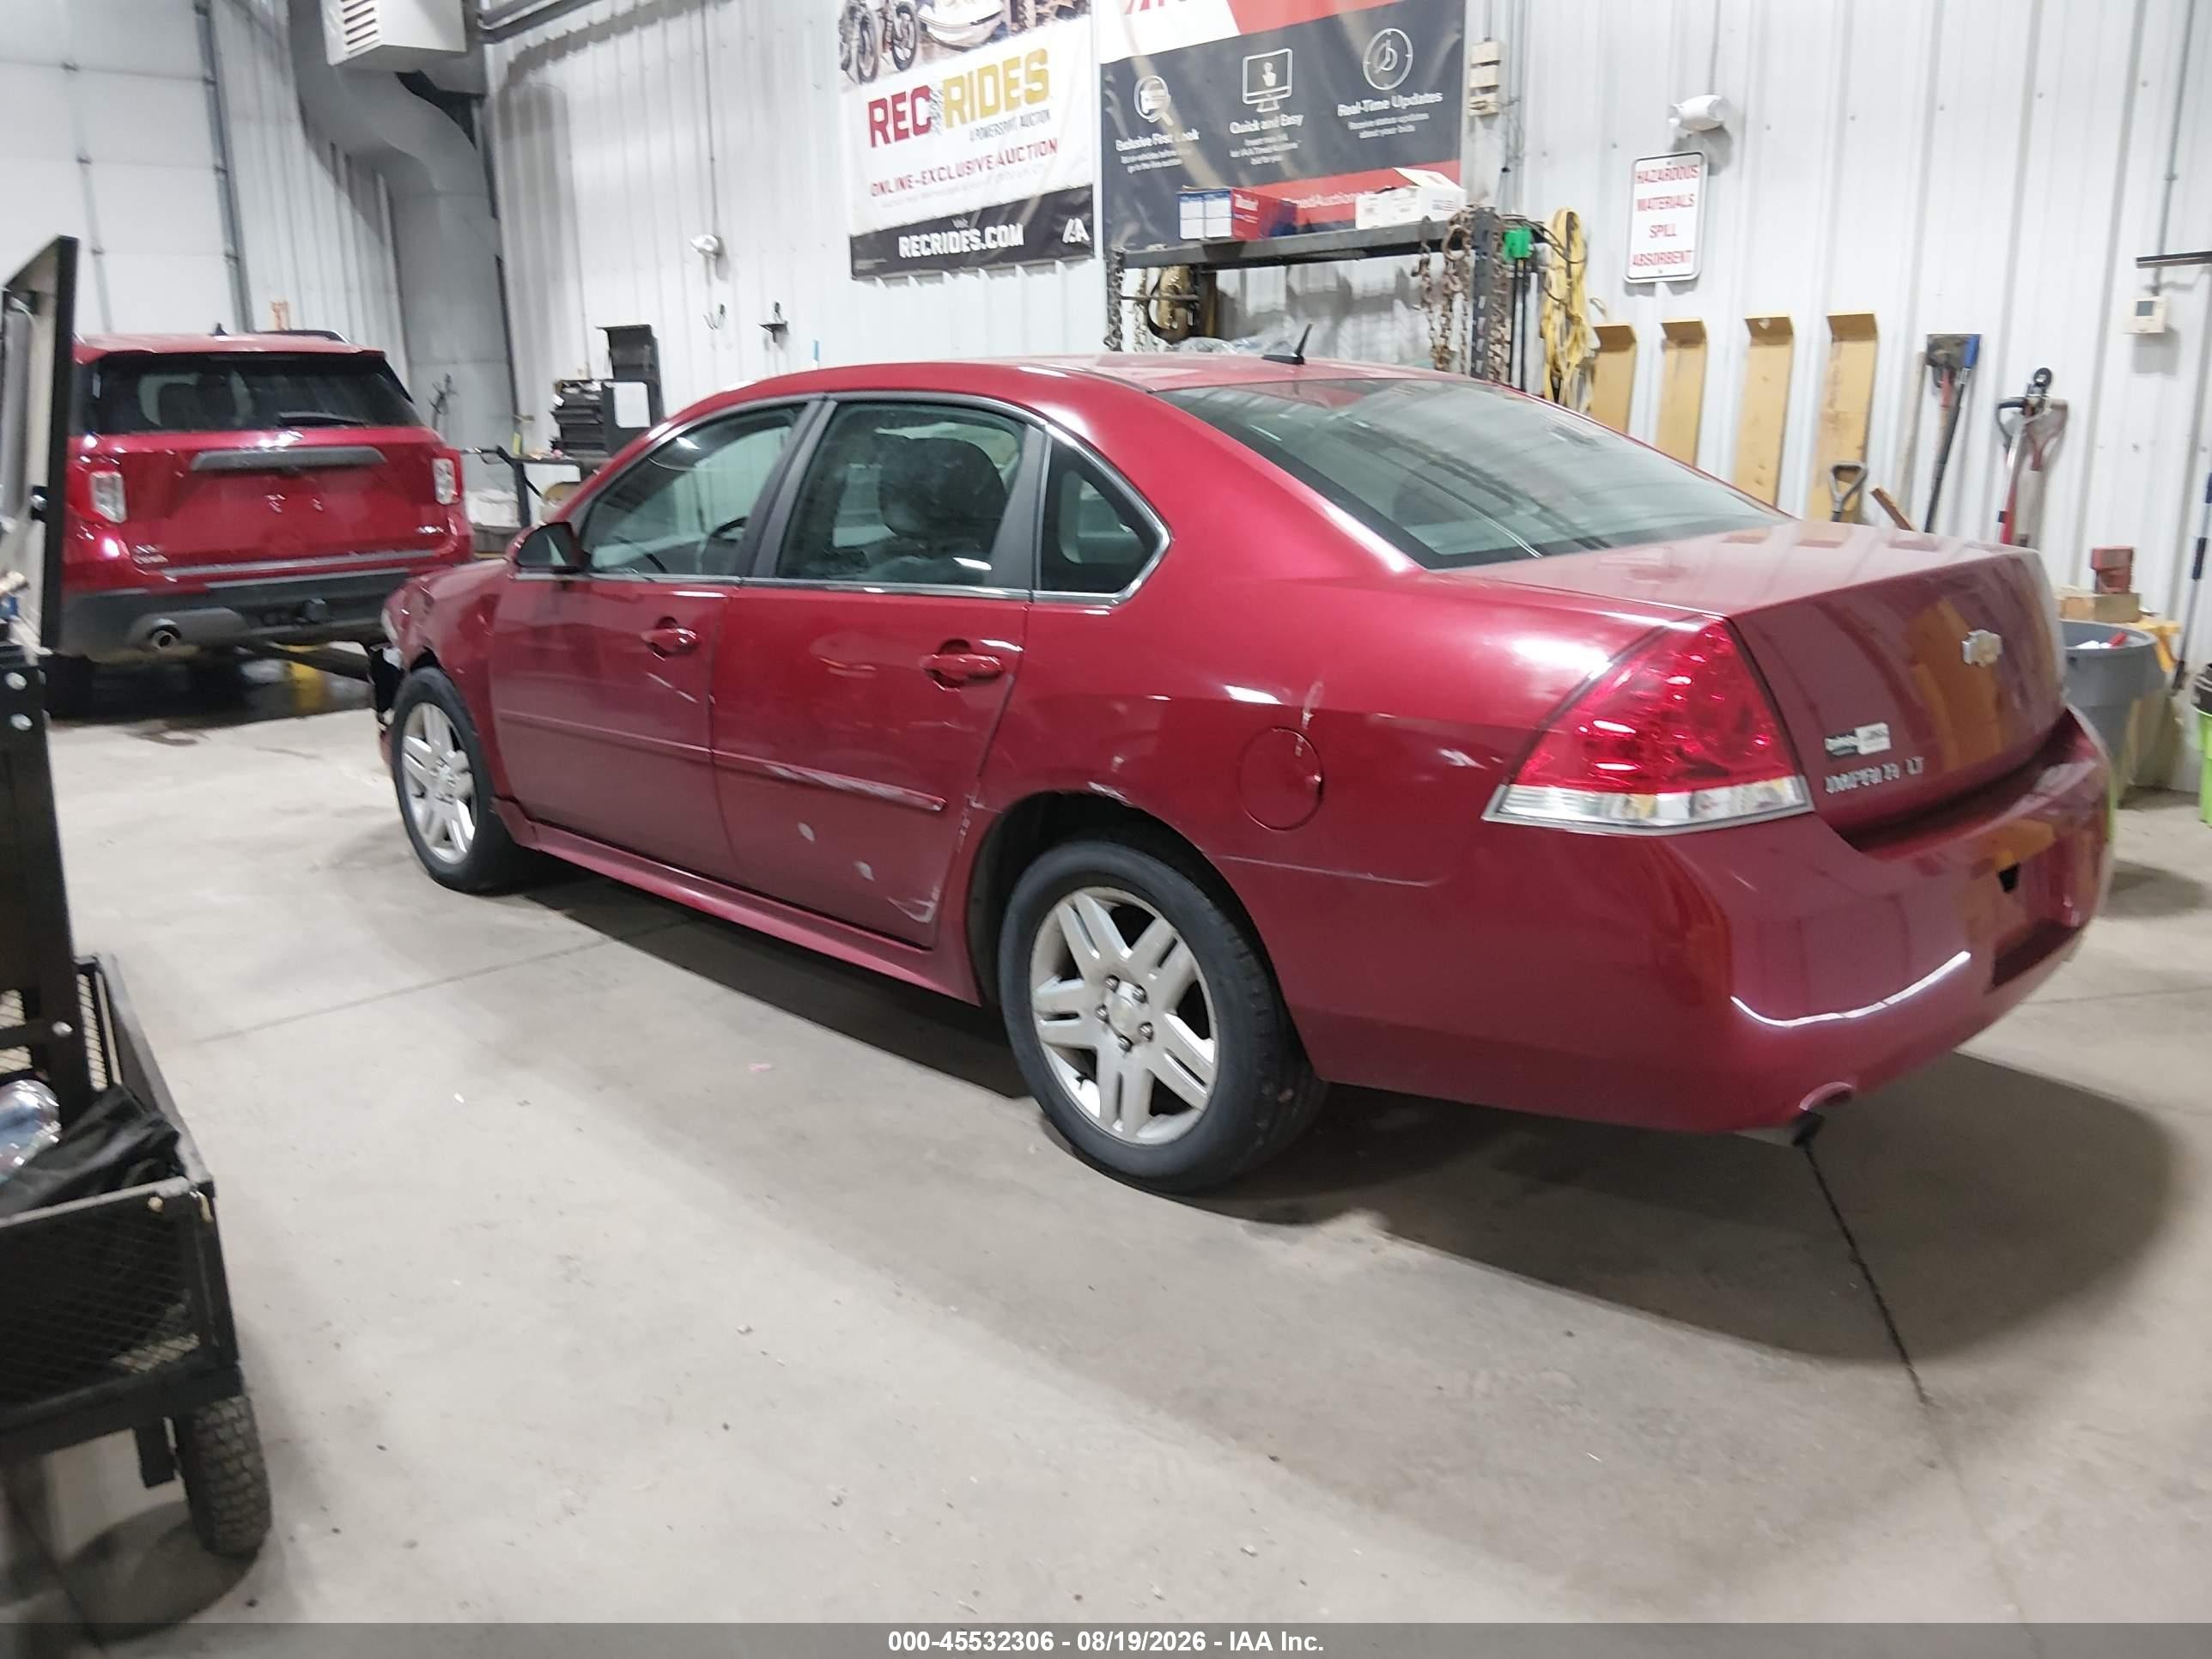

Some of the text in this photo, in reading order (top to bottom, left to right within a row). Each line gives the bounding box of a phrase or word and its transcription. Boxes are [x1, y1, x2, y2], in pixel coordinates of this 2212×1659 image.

[867, 84, 932, 148] REC
[942, 48, 1049, 129] RIDES
[898, 223, 1024, 258] RECRIDES.COM
